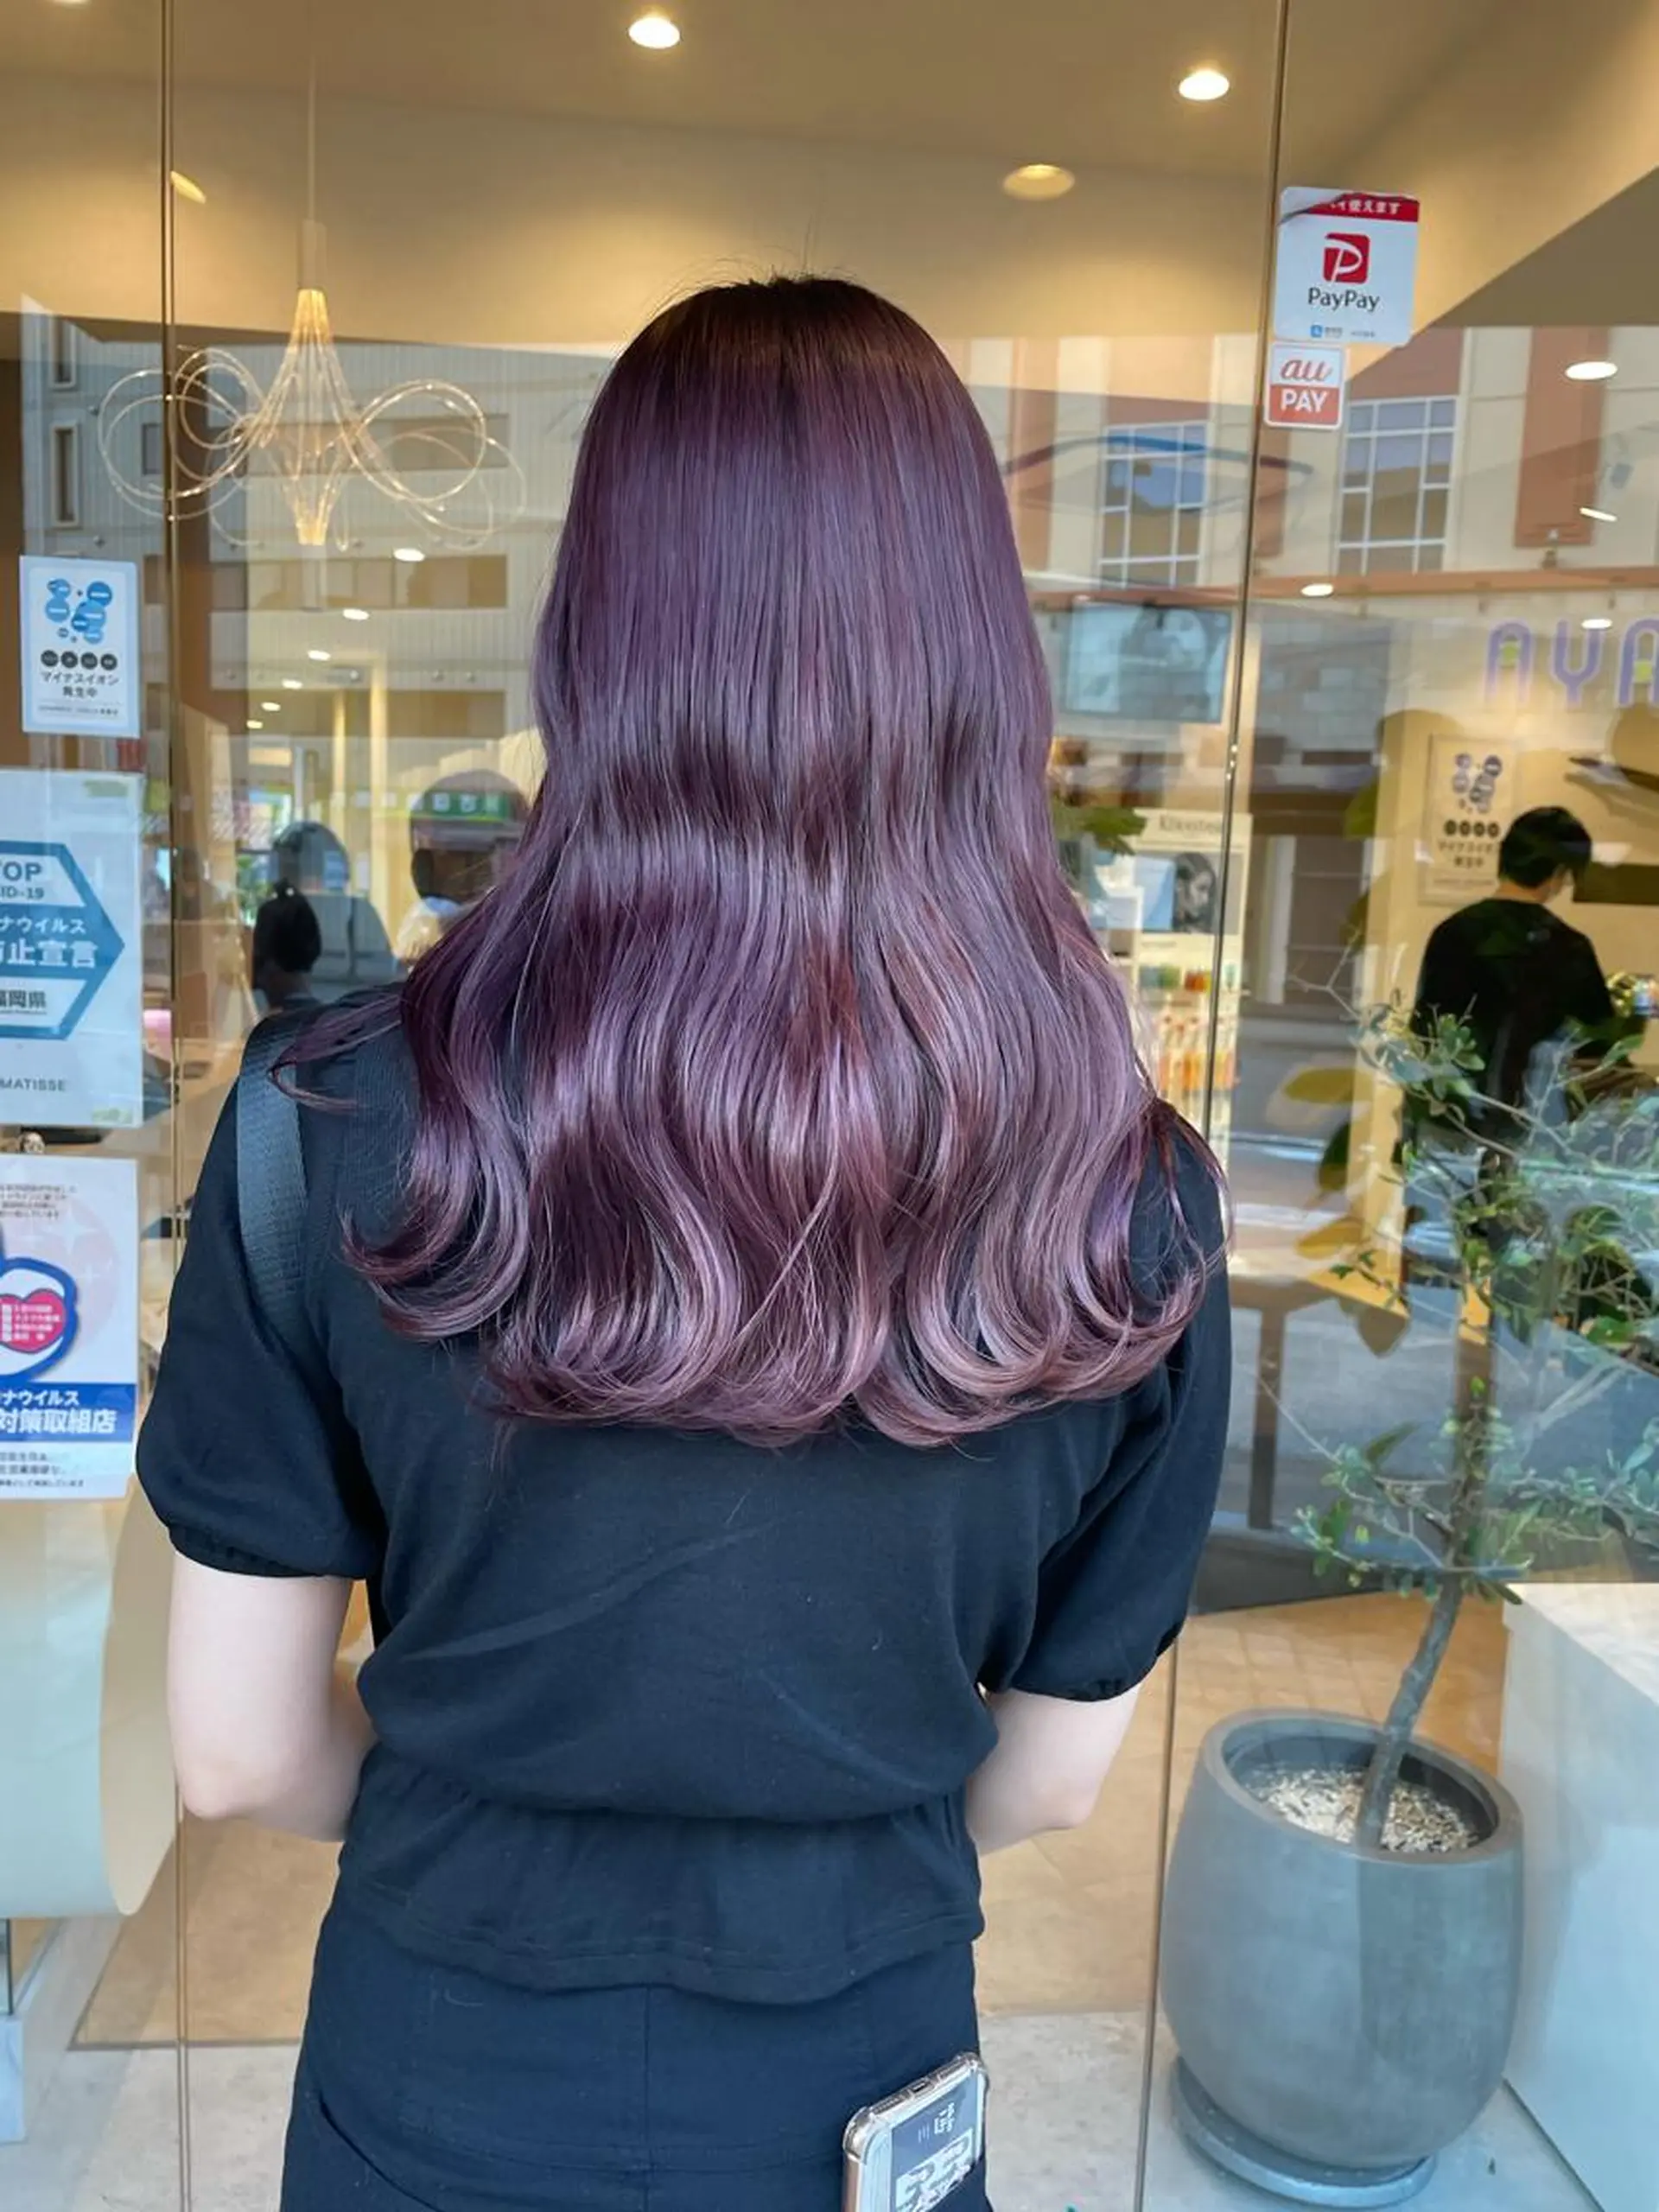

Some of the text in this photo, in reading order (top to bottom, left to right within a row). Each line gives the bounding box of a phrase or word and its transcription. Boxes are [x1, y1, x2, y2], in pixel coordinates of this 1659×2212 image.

[1307, 287, 1380, 313] PayPay
[1281, 359, 1333, 382] au
[1281, 388, 1329, 413] PAY
[40, 671, 120, 687] マイナスイオン
[0, 861, 42, 882] OP
[0, 914, 87, 934] ナウイルス
[0, 938, 99, 968] 止宣言
